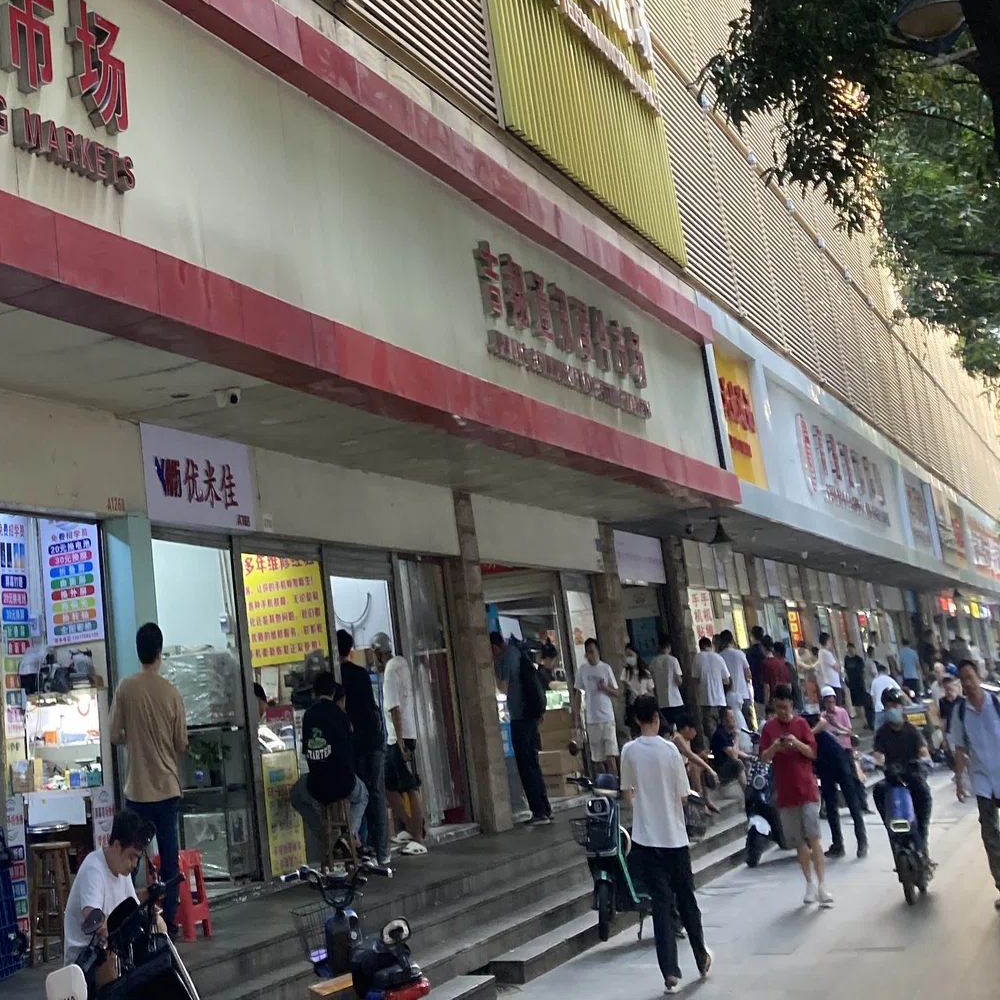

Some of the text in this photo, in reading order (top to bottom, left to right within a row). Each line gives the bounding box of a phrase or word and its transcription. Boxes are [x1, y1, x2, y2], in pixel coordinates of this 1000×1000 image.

[13, 107, 136, 193] MARKETS
[184, 457, 238, 510] 优米佳
